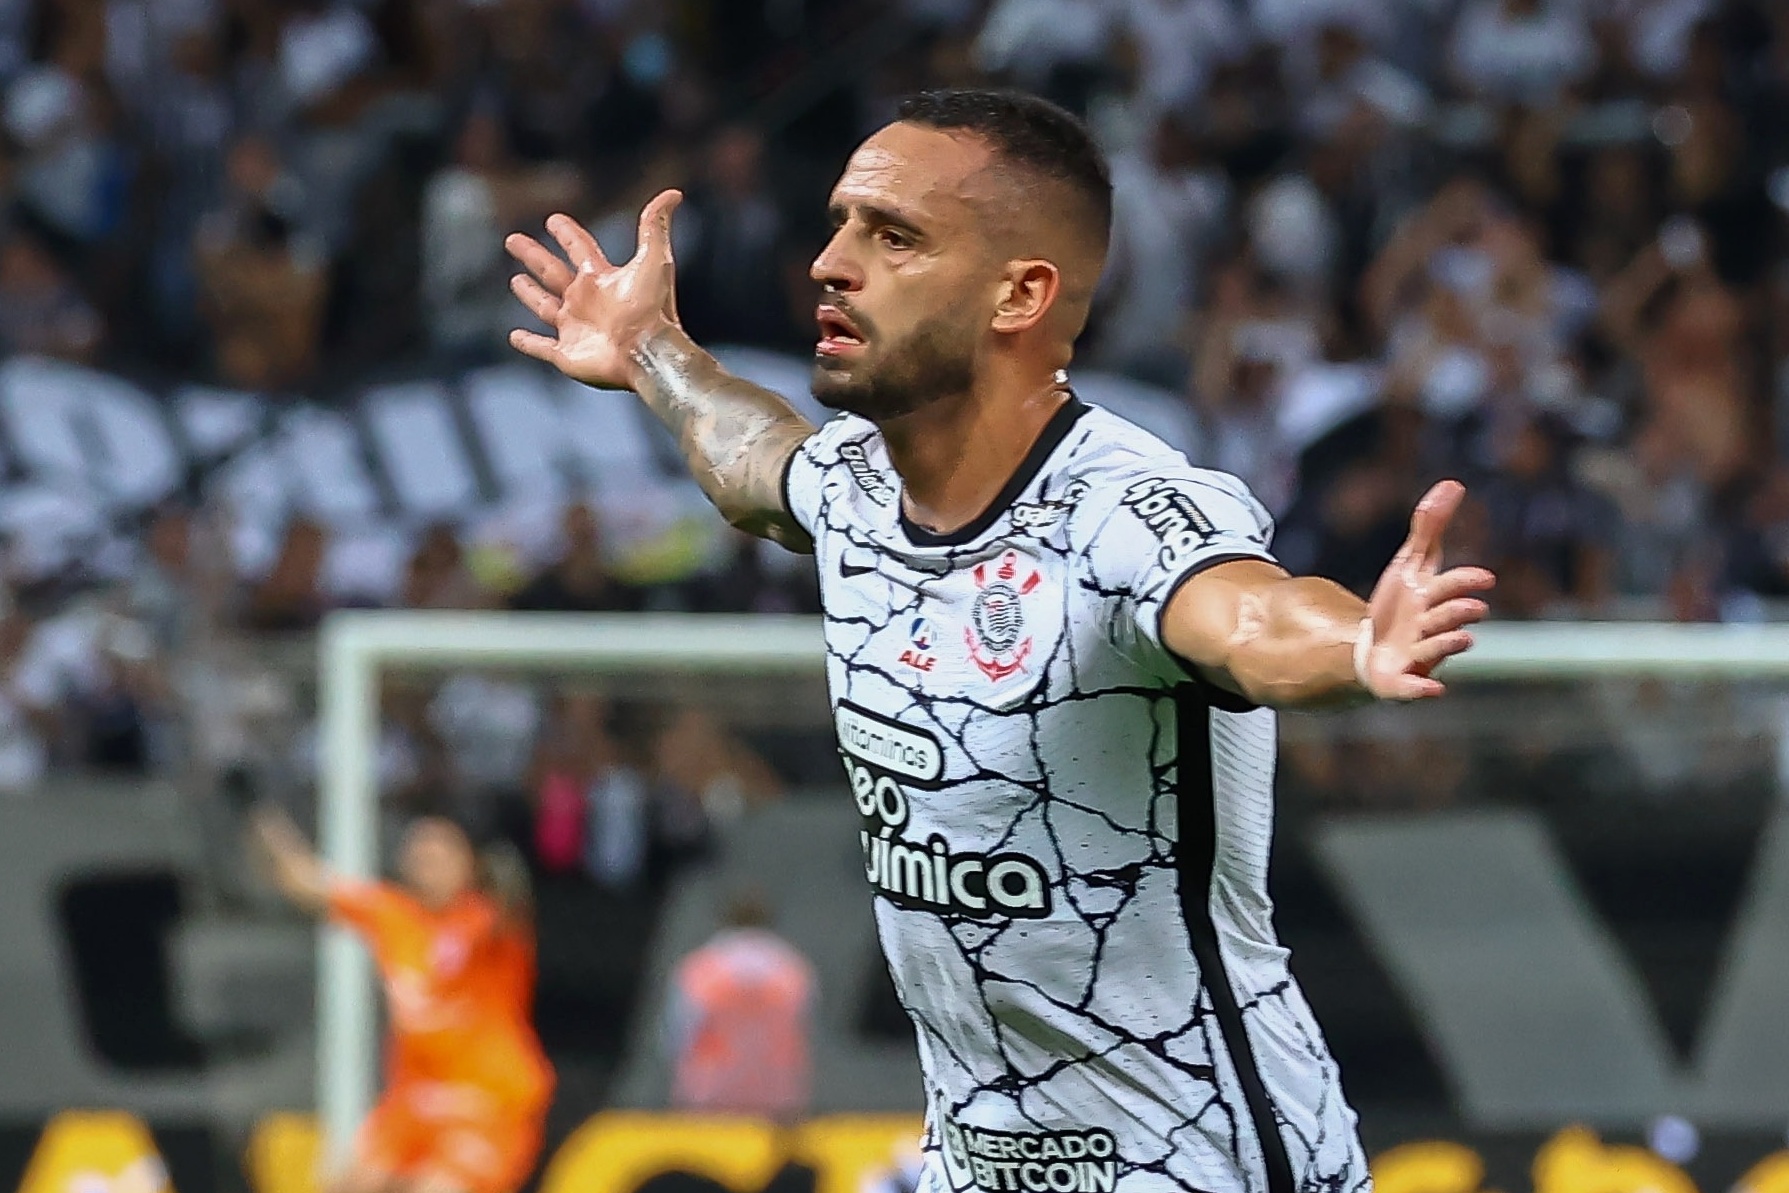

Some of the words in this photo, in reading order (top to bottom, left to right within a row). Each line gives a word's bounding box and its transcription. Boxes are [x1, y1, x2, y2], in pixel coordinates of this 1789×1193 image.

[1131, 487, 1206, 572] bmg
[897, 650, 937, 672] ALE
[861, 826, 1045, 909] uímica
[965, 1129, 1114, 1160] MERCADO
